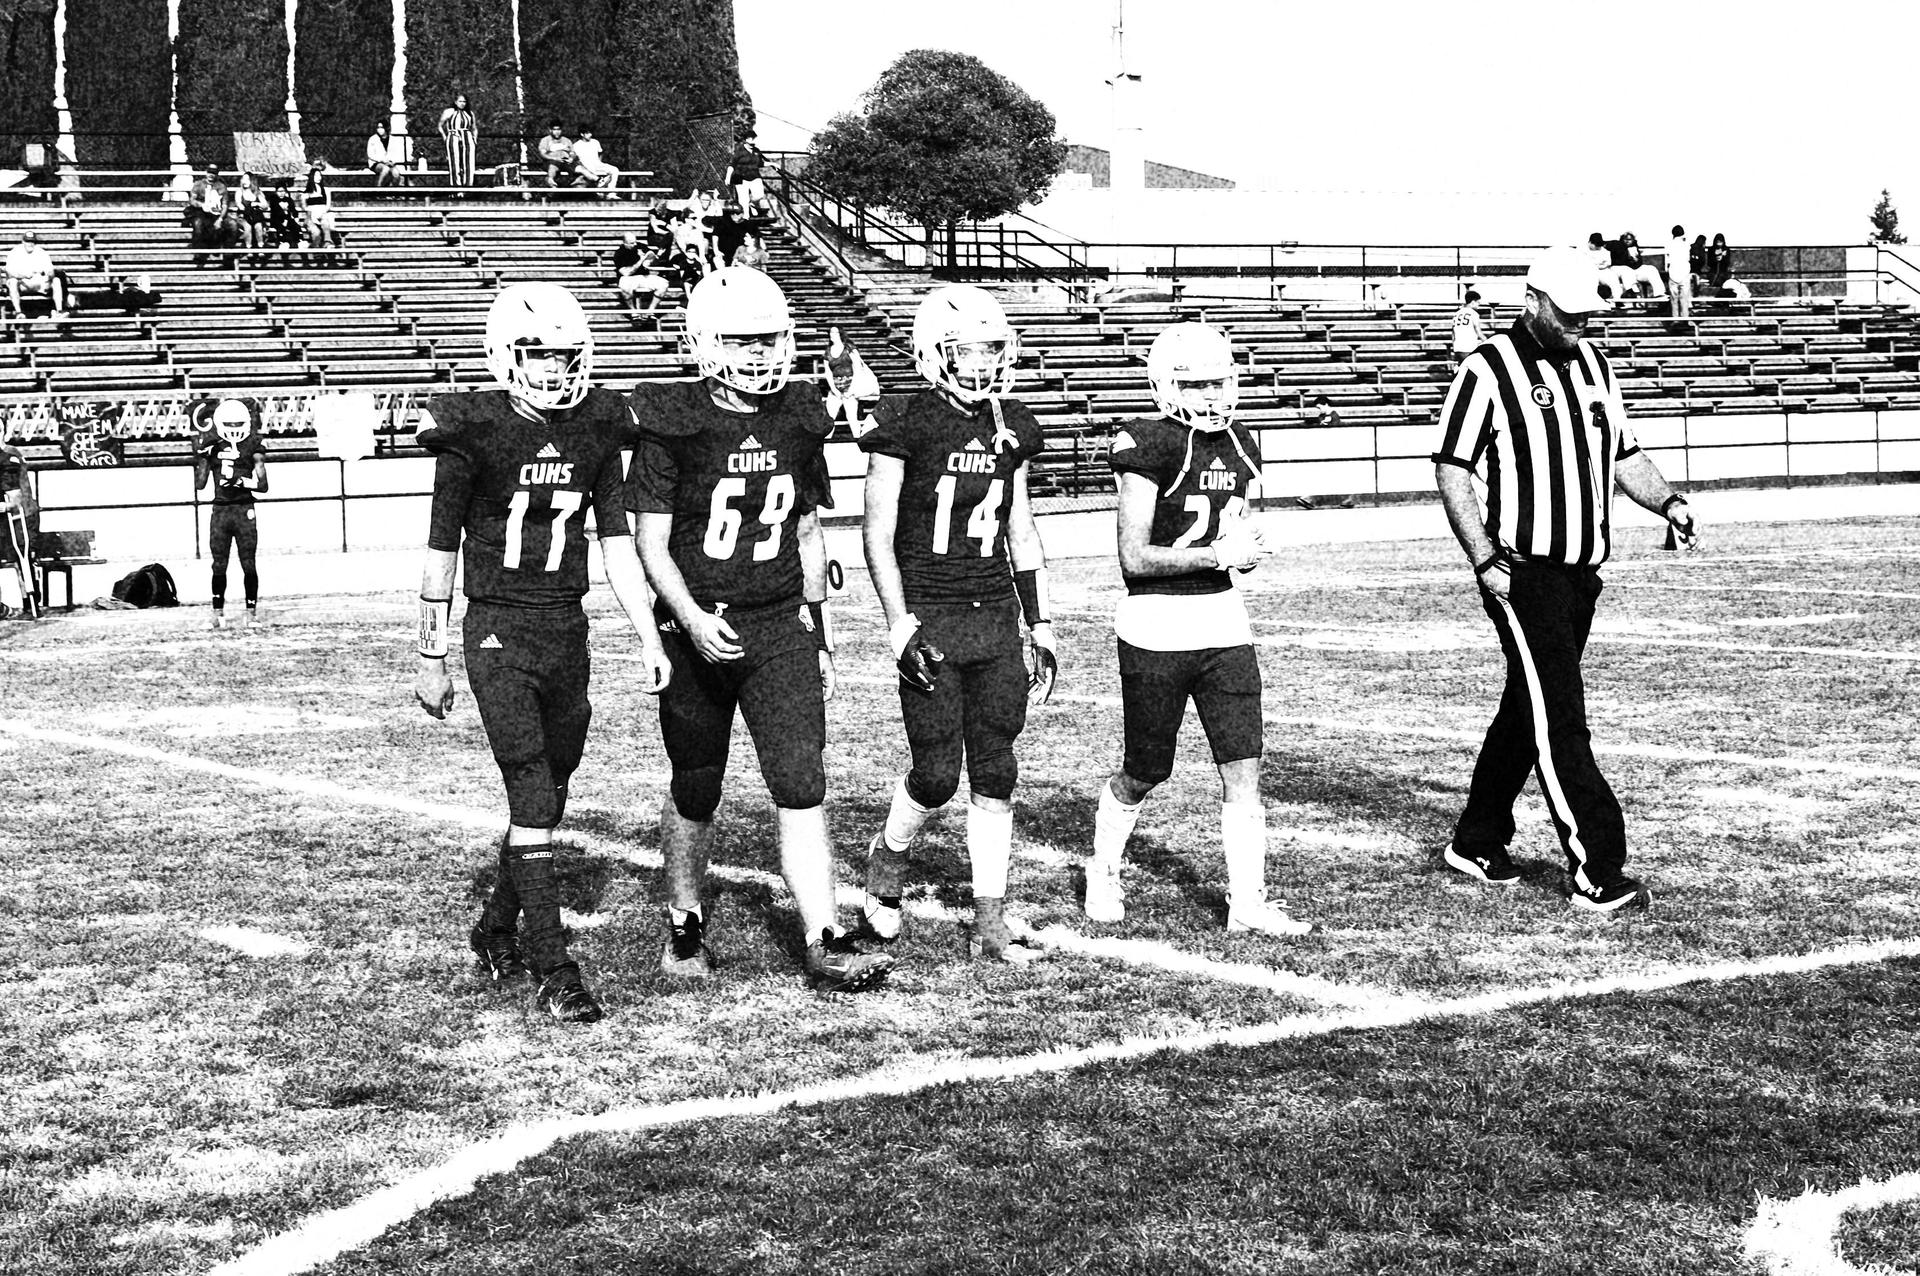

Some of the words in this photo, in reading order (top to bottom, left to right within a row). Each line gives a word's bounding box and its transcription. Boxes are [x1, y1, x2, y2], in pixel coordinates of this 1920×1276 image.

[62, 403, 98, 420] MAKE
[71, 432, 100, 452] SEE
[727, 449, 778, 473] CUHS
[946, 451, 998, 474] CUHS
[518, 462, 575, 485] CUHS
[1198, 470, 1238, 491] CUHS
[702, 473, 796, 561] 69
[931, 474, 1005, 558] 14
[503, 490, 584, 572] 17
